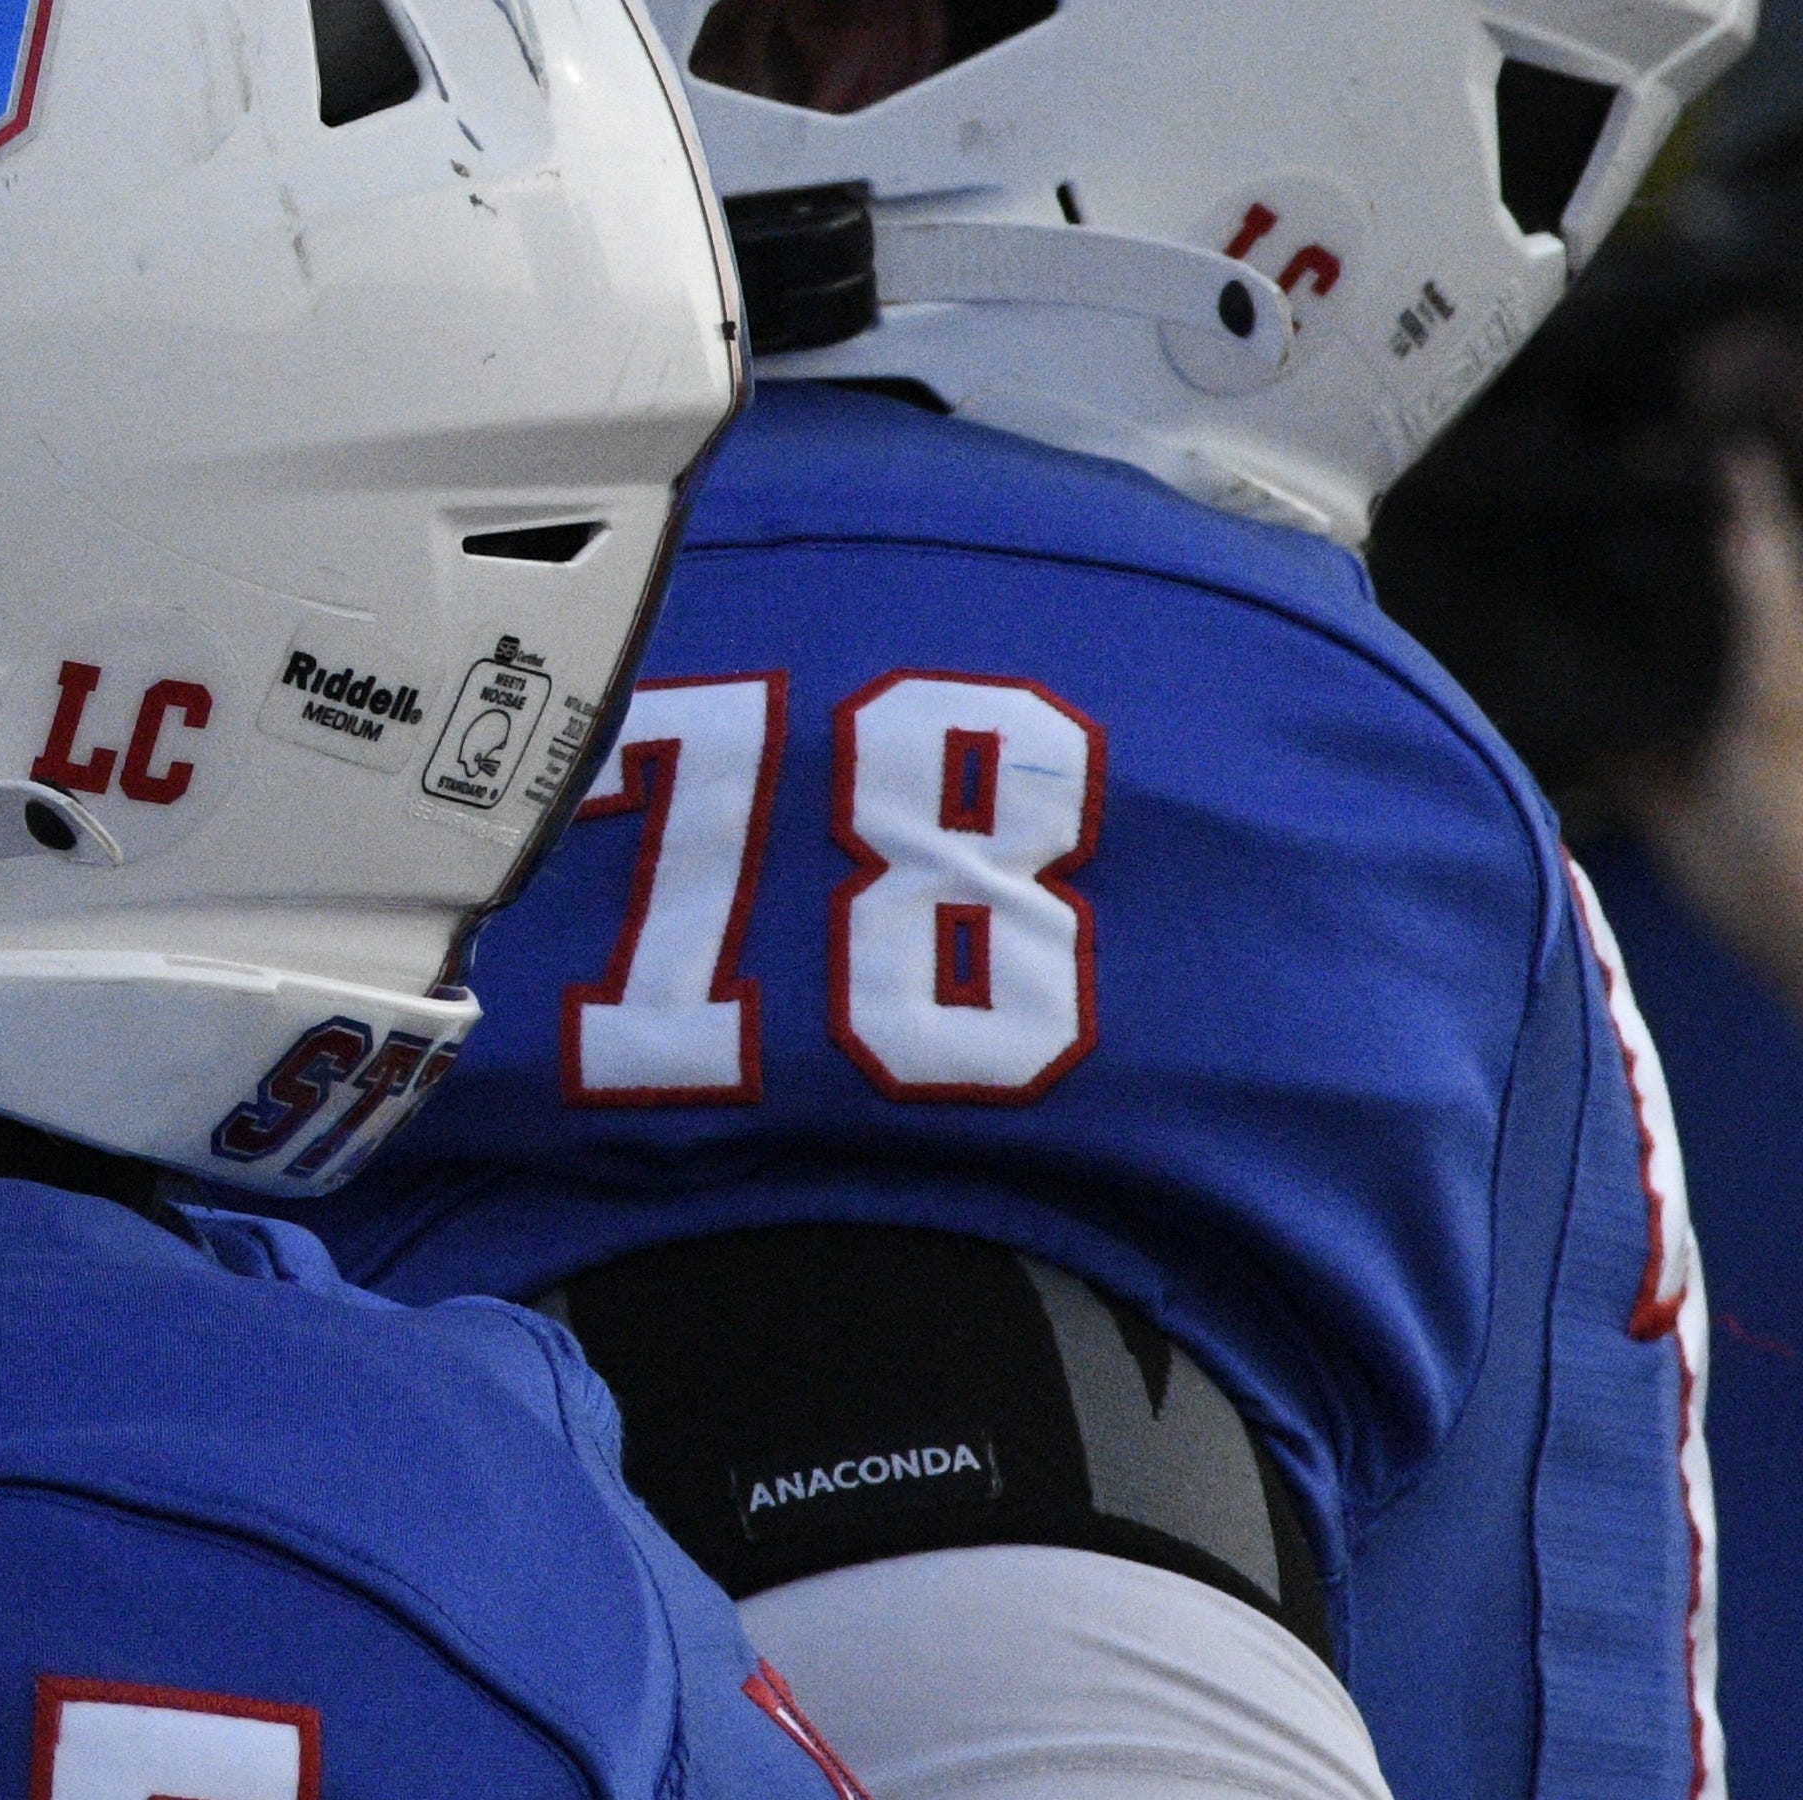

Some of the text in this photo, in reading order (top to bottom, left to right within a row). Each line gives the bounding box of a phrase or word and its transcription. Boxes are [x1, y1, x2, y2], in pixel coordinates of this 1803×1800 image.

[479, 685, 528, 711] NOCSAE
[494, 672, 527, 692] MEETS
[30, 661, 212, 805] LC
[301, 701, 385, 742] MEDIUM
[437, 775, 489, 800] STANDARD
[561, 667, 1107, 1108] 78
[748, 1443, 982, 1514] ANACONDA
